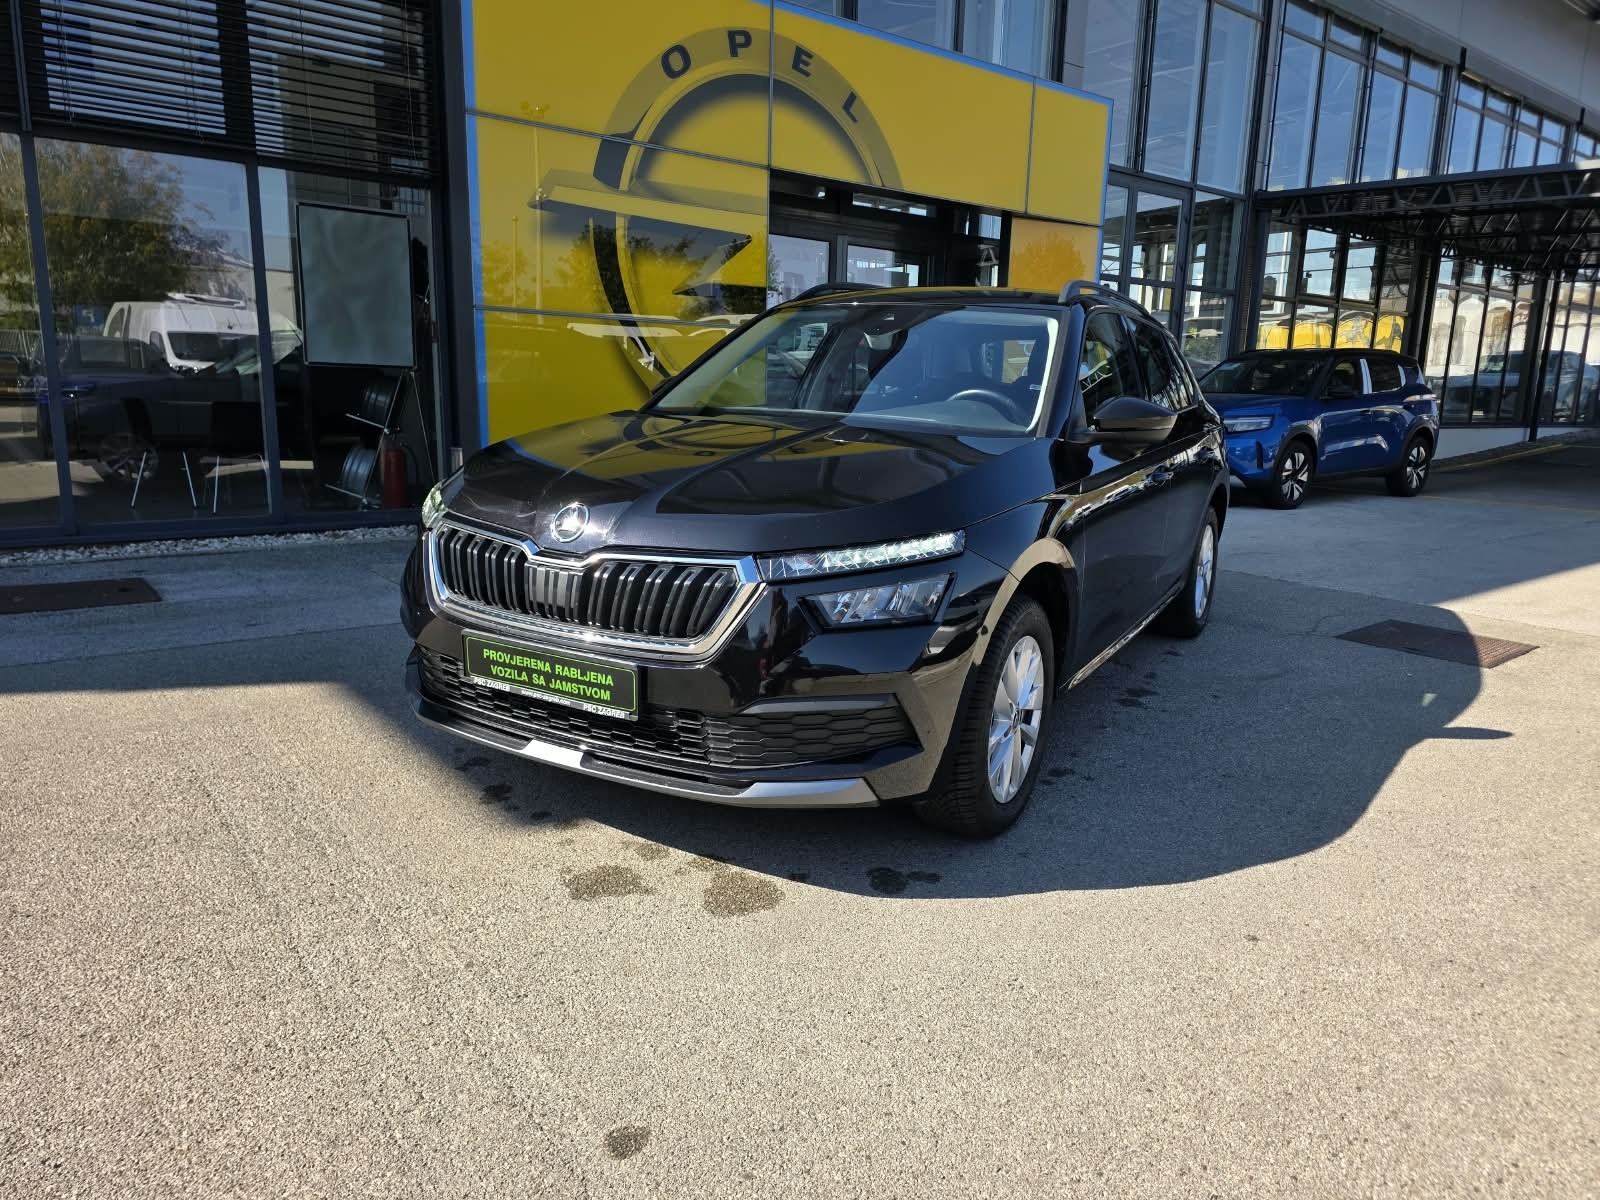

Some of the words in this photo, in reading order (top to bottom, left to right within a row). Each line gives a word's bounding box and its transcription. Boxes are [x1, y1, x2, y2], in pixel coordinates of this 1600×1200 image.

[661, 29, 858, 123] OPEL
[483, 649, 551, 673] PROVJERENA
[555, 664, 614, 686] RABLJENA
[490, 665, 528, 682] VOZILA
[532, 673, 546, 686] SA
[549, 678, 611, 701] JAMSTVOM
[487, 680, 511, 692] ZAGREB
[583, 703, 596, 712] PSC
[597, 706, 625, 719] ZAGREB
